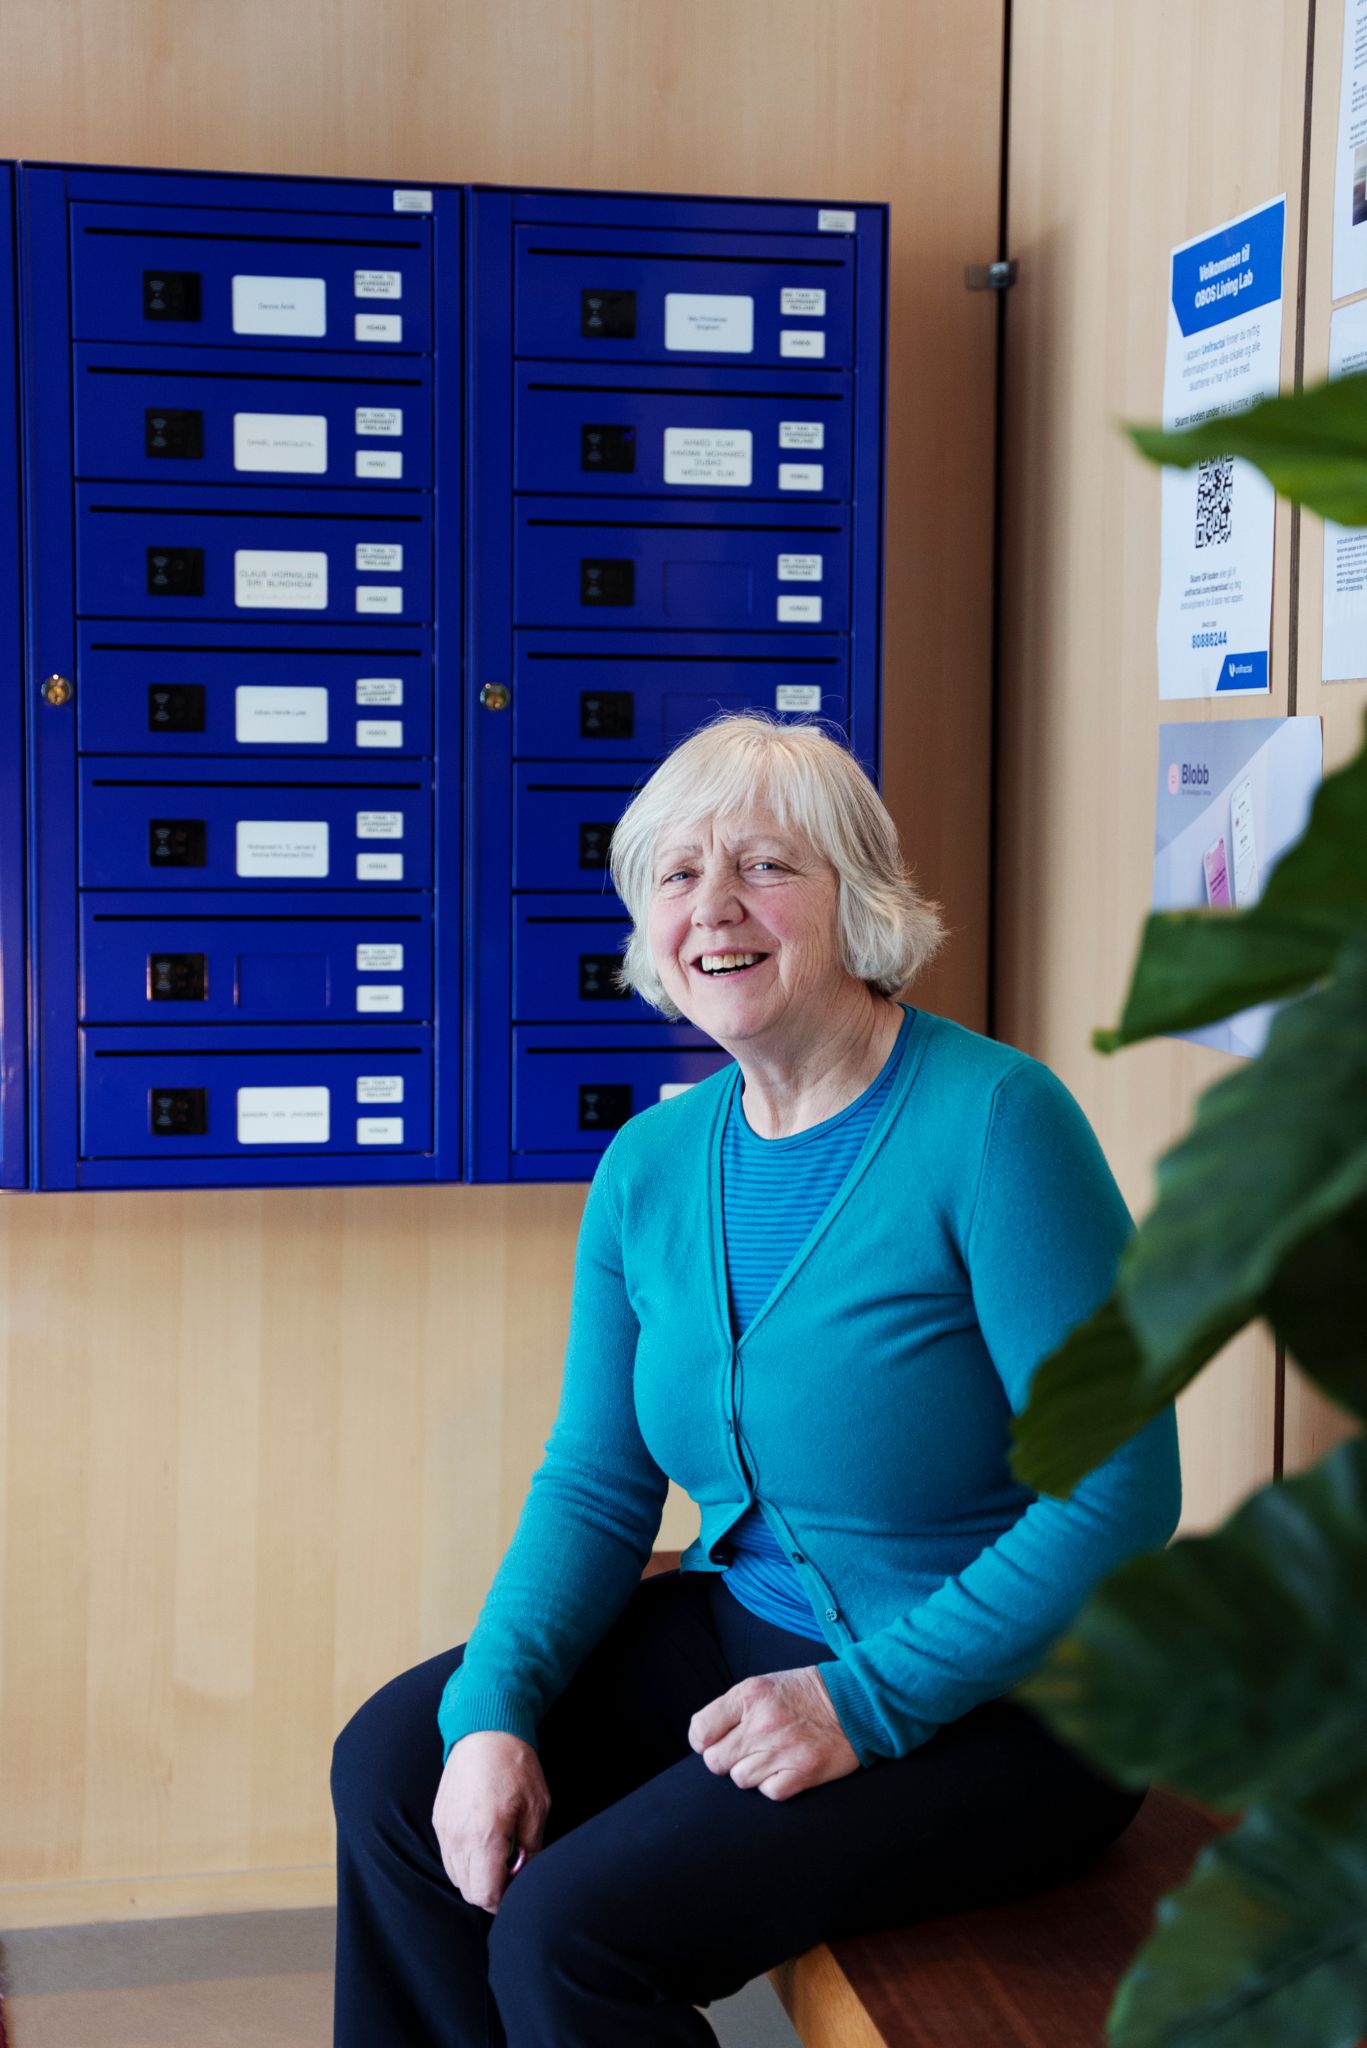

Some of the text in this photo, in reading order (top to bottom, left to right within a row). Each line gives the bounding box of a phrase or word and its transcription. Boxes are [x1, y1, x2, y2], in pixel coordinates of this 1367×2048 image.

[1199, 243, 1250, 282] Velkommen til
[1194, 268, 1253, 309] OBOS Living Lab
[1182, 763, 1209, 785] Blobb
